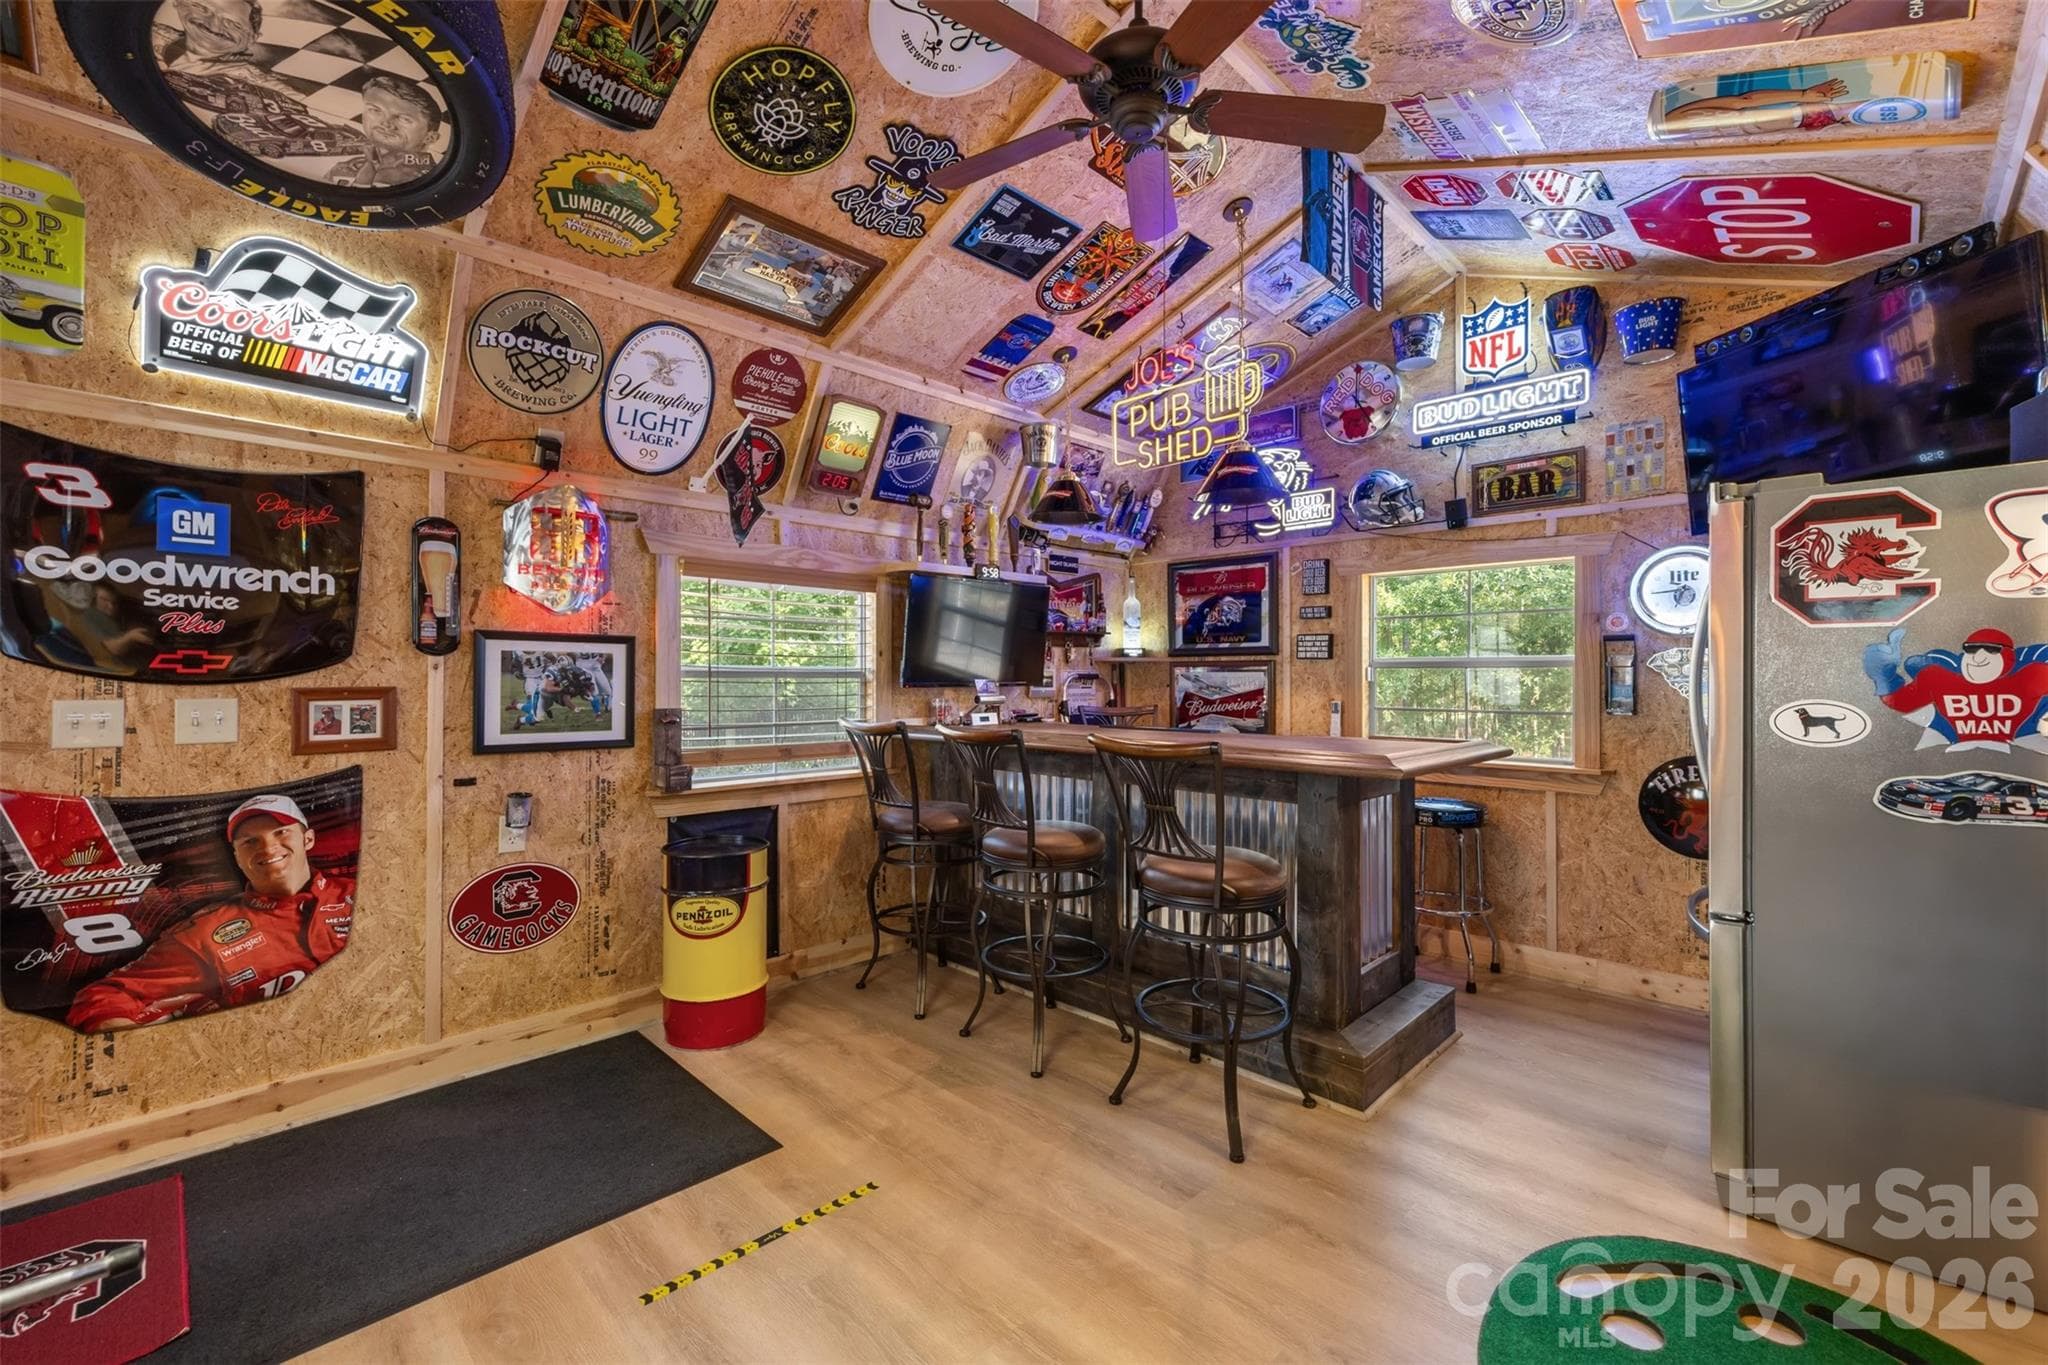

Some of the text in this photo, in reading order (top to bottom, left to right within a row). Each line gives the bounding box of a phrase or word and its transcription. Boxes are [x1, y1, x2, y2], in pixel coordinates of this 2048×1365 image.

[1712, 1, 1796, 26] The Old
[901, 32, 939, 71] BREWING
[742, 58, 843, 136] HOPFLY
[722, 110, 785, 166] BREWING
[1437, 117, 1466, 142] BREW
[404, 152, 431, 166] Bud
[231, 178, 370, 227] EAGLE
[557, 191, 654, 236] LUMBERYARD
[834, 186, 924, 237] RANGER
[1330, 152, 1346, 283] PANTHERS
[1701, 185, 1816, 260] STOP
[979, 226, 1061, 250] Bad Martha
[1372, 192, 1383, 312] GAMECOCKS
[1045, 249, 1085, 287] SUN KING
[158, 278, 294, 342] Coors
[1638, 315, 1657, 324] BUD
[171, 321, 245, 348] OFFICIAL
[660, 330, 690, 344] OLDEST
[1635, 319, 1660, 330] LIGHT
[167, 335, 215, 357] BEER
[218, 345, 243, 361] OF
[292, 322, 417, 367] LIGHT
[476, 325, 599, 374] ROCKCUT
[1467, 328, 1523, 370] NFL
[747, 364, 784, 383] PIEHOLE
[1125, 341, 1197, 392] JOE'S
[495, 379, 557, 407] BREWING
[608, 373, 705, 416] Yuengling
[1324, 371, 1396, 415] RED DOG
[1419, 375, 1583, 428] BUD LIGHT
[616, 405, 693, 437] LIGHT
[1129, 391, 1192, 437] PUB
[629, 430, 674, 448] LAGER
[1431, 414, 1562, 446] OFFICIAL BEER SPONSOR
[639, 447, 659, 461] 99
[886, 448, 941, 470] BLUE MOON
[1138, 426, 1213, 469] SHED
[23, 461, 113, 510] 3
[1497, 469, 1557, 501] BAR
[1286, 503, 1331, 522] LIGHT
[1291, 493, 1325, 509] BUD
[171, 509, 216, 537] GM
[24, 545, 336, 596] Goodwrench
[982, 566, 1000, 579] 9:58
[1303, 560, 1326, 569] DRINK
[1669, 569, 1700, 586] Lite
[143, 588, 240, 611] Service
[159, 611, 226, 635] Plus
[1185, 698, 1257, 716] Budweiser
[1943, 694, 2022, 718] BUD
[1955, 720, 2012, 734] MAN
[2006, 796, 2034, 815] 3
[4, 862, 163, 890] Budweiser
[455, 898, 575, 948] GAMECOCKS
[676, 907, 734, 921] PENNZOIL
[63, 912, 144, 954] 8
[221, 934, 264, 957] Wrangler
